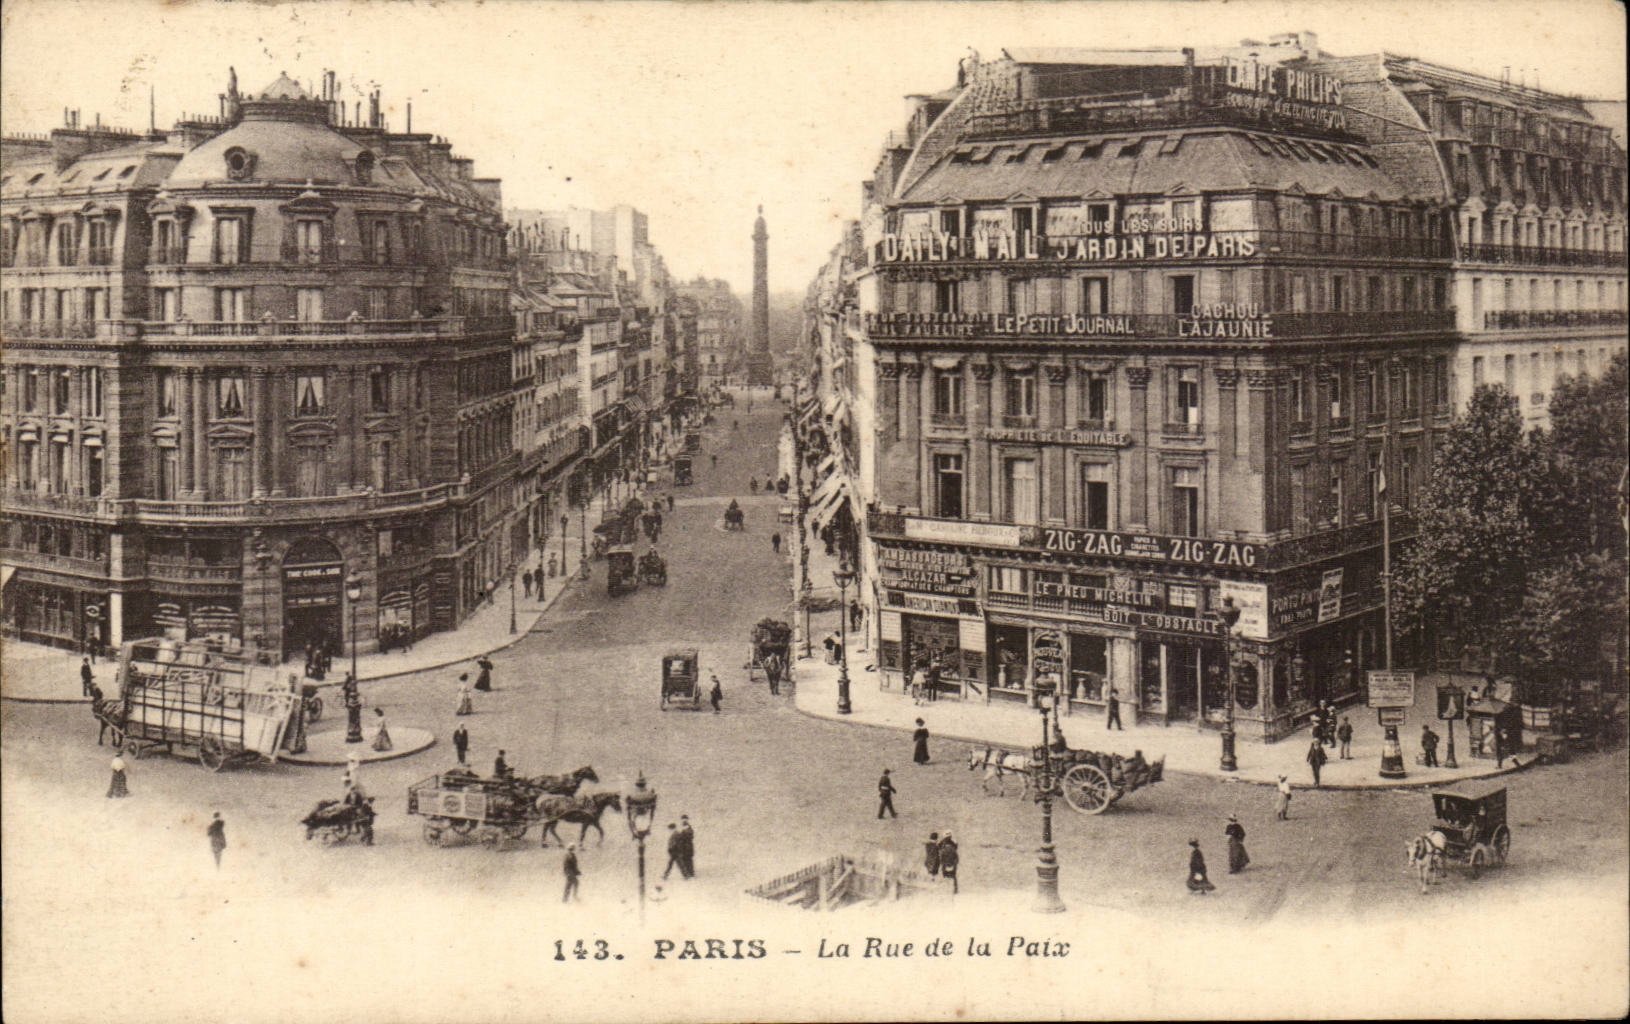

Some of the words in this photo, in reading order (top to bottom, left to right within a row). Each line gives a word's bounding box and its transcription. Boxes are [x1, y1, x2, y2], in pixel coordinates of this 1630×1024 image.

[1286, 69, 1342, 106] PHILIPS
[1160, 217, 1203, 232] SOIRS
[885, 230, 950, 262] DAILY
[974, 229, 1039, 260] MAIL
[1057, 237, 1146, 261] JARDIN
[1156, 237, 1185, 258] DE
[1194, 235, 1256, 258] PARIS
[1191, 303, 1259, 320] CACHOU
[994, 314, 1015, 333] LE
[1016, 314, 1060, 334] PETIT
[1064, 314, 1135, 334] JOURNAL
[1178, 319, 1274, 338] LAJAUNIE
[902, 570, 947, 585] ALCAZAR
[1036, 582, 1050, 597] LE
[1057, 584, 1087, 599] PNEU
[1095, 588, 1151, 605] MICHELIN
[1103, 608, 1131, 624] BOIT
